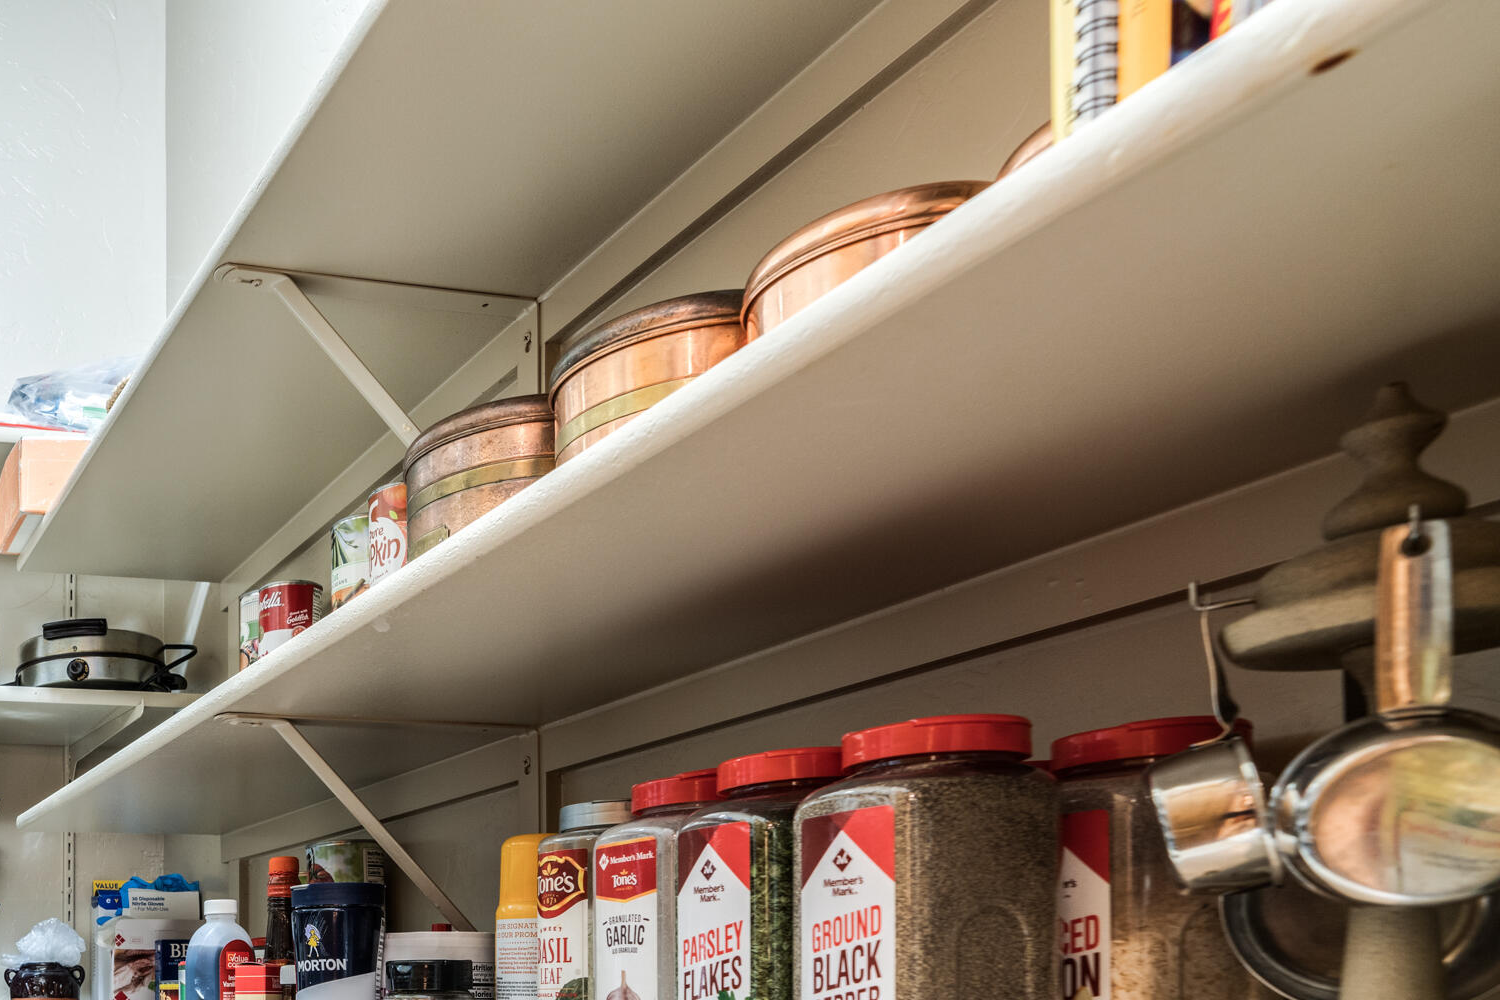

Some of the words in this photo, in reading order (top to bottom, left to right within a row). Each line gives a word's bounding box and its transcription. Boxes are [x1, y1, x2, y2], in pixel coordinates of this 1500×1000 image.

[609, 854, 636, 865] Member's
[636, 850, 655, 860] Mark
[538, 872, 575, 897] Tone's
[611, 872, 638, 888] Tone's
[822, 875, 864, 889] Member's
[693, 883, 725, 894] Member's
[831, 885, 858, 897] Mark
[699, 894, 721, 903] Mark
[608, 914, 642, 925] GRANULATED
[606, 925, 645, 948] GARLIC
[811, 904, 883, 954] GROUND
[682, 919, 744, 967] PARSLEY
[296, 958, 349, 973] MORTON
[811, 939, 883, 995] BLACK
[540, 967, 563, 985] LEAF
